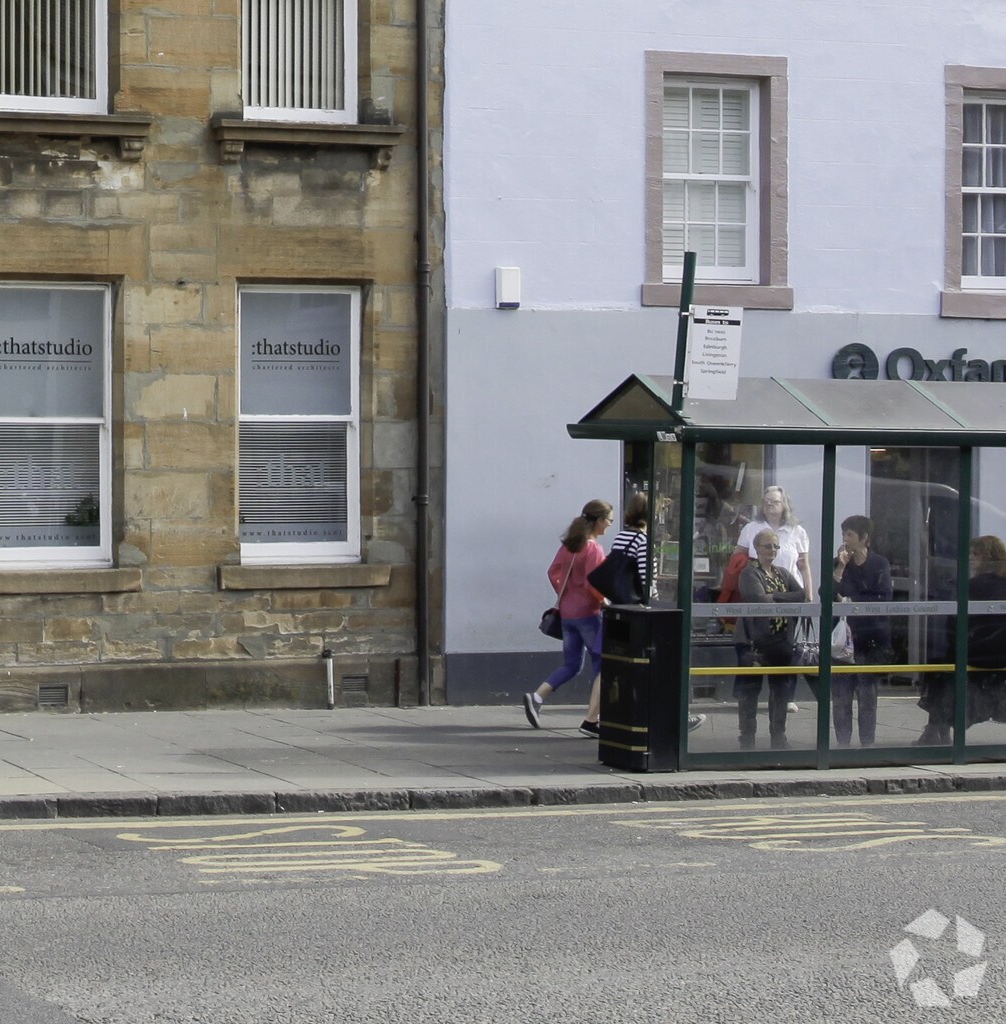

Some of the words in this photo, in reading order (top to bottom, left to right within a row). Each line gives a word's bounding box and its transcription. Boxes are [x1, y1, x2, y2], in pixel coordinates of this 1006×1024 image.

[251, 338, 341, 356] :thatstudio
[725, 606, 742, 614] West
[747, 606, 772, 614] Lothian
[775, 606, 802, 614] Council
[885, 605, 911, 613] Lothian
[913, 605, 939, 613] Council
